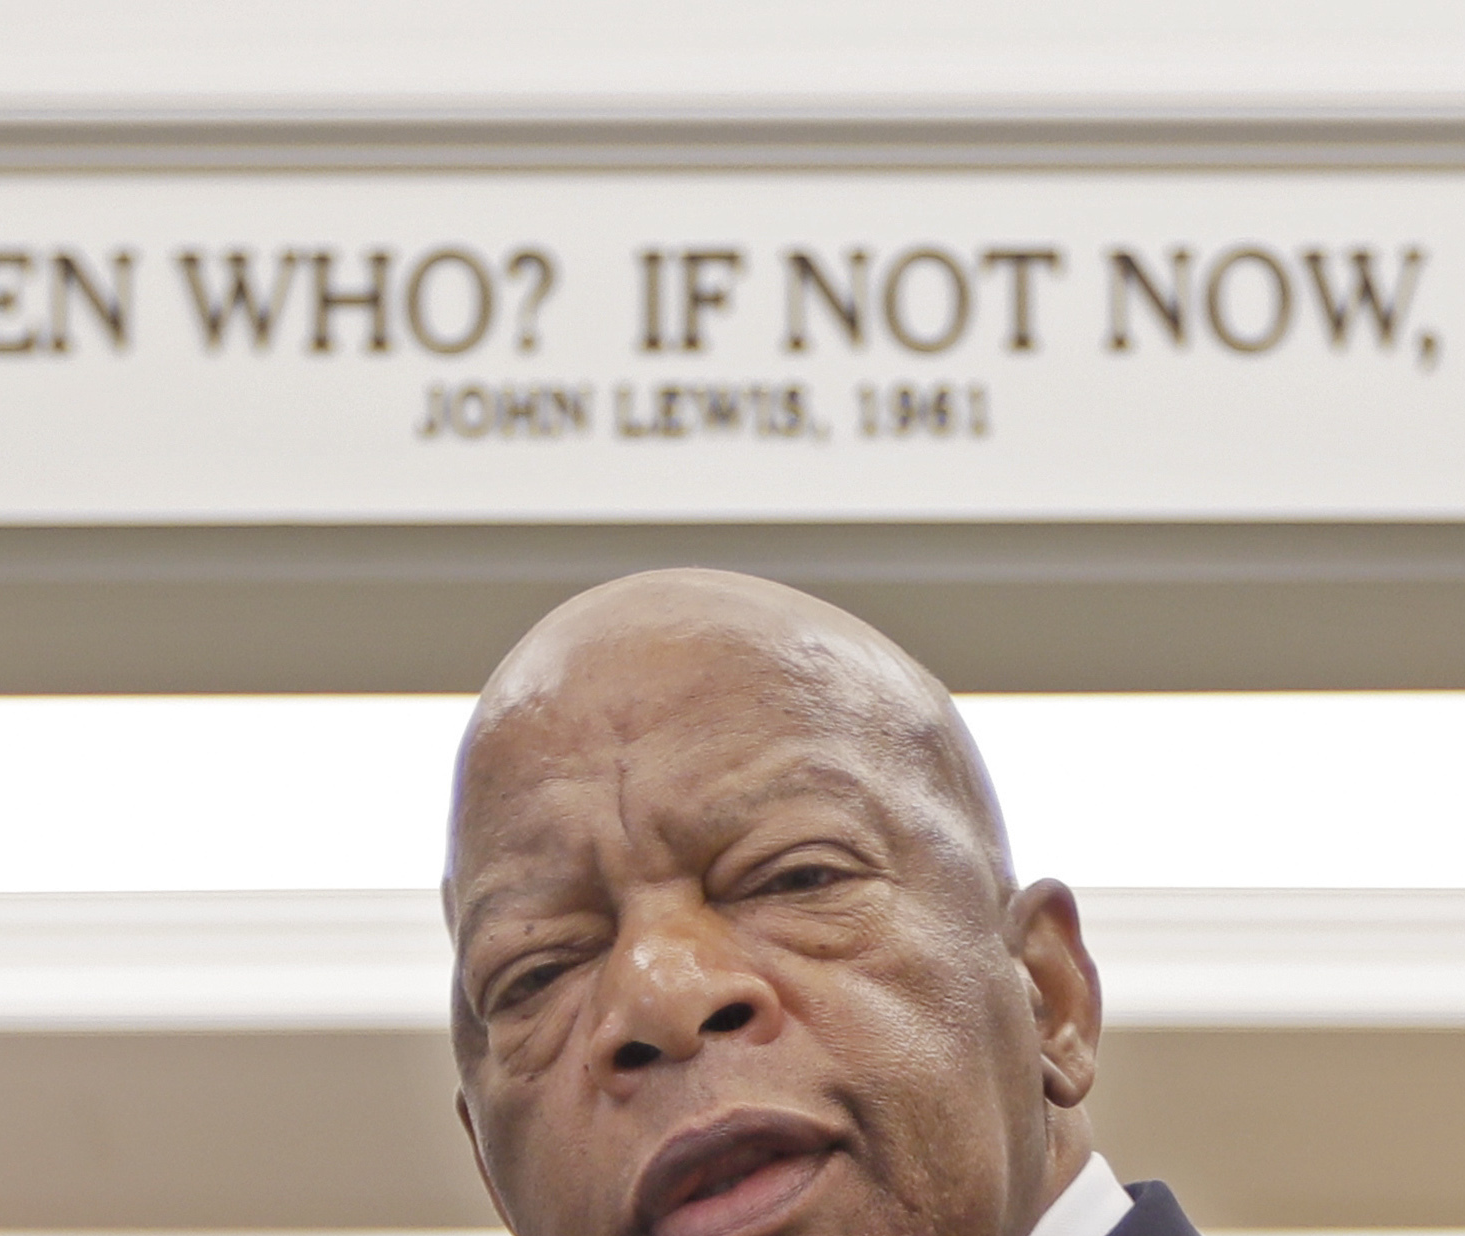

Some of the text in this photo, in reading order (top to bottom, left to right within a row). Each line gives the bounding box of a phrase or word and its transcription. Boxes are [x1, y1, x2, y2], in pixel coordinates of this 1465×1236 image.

[173, 246, 560, 359] WHO?
[635, 246, 748, 357] IF
[781, 245, 1066, 358] NOT
[1104, 245, 1442, 370] NOW,
[417, 383, 992, 443] JOHN LEWIS, 1961
